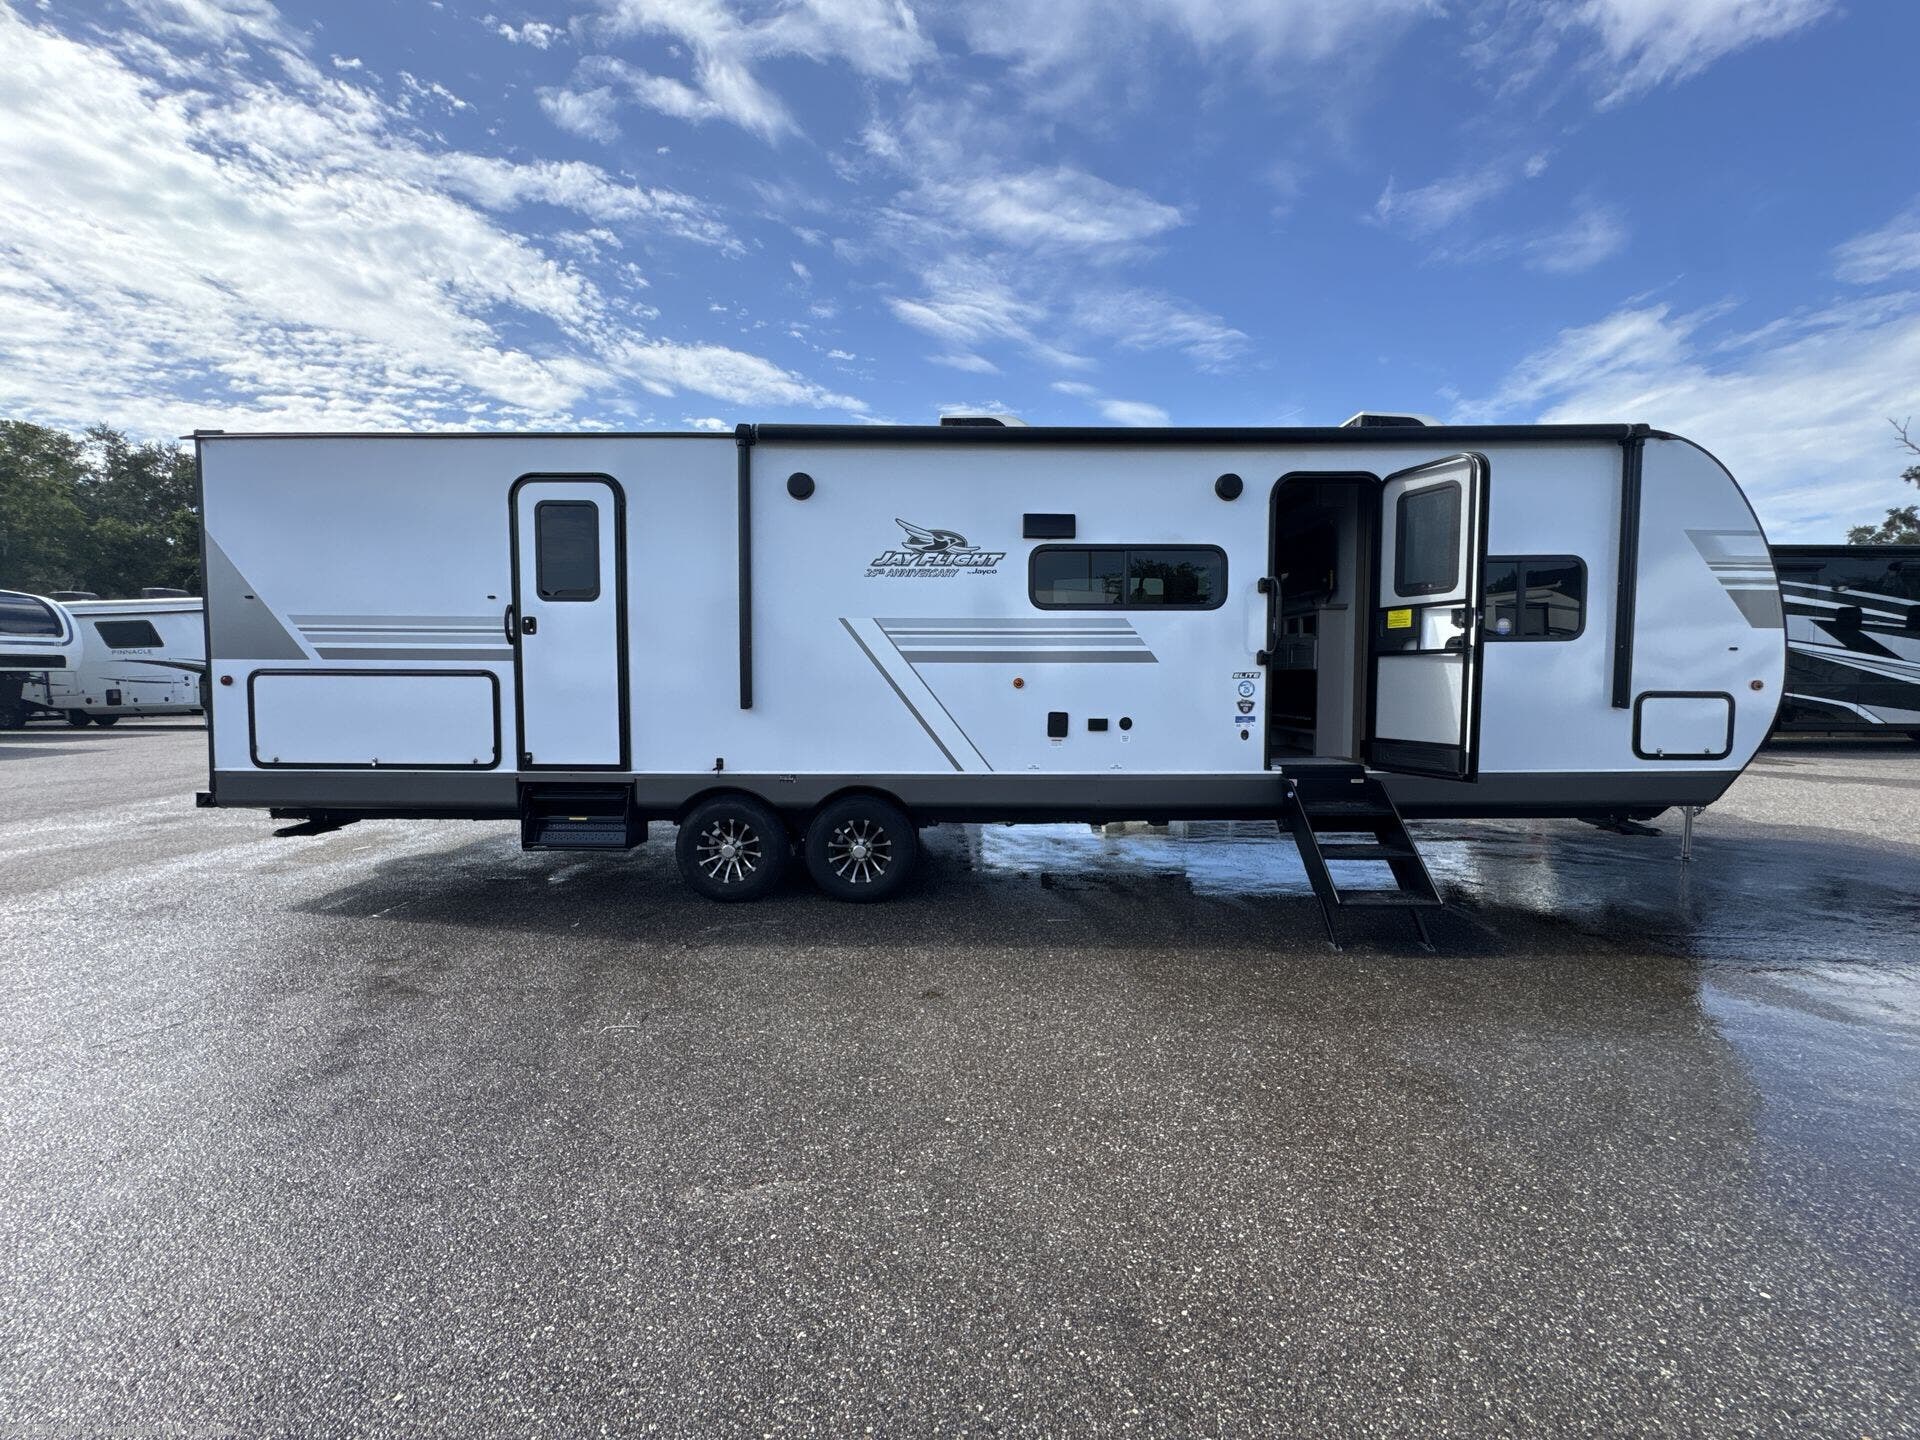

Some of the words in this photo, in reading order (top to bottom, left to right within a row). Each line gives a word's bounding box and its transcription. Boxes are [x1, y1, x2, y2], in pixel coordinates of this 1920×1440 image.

[871, 551, 917, 567] JAY
[916, 552, 1007, 567] FLIGHT
[885, 568, 959, 577] ANNIVERSARY
